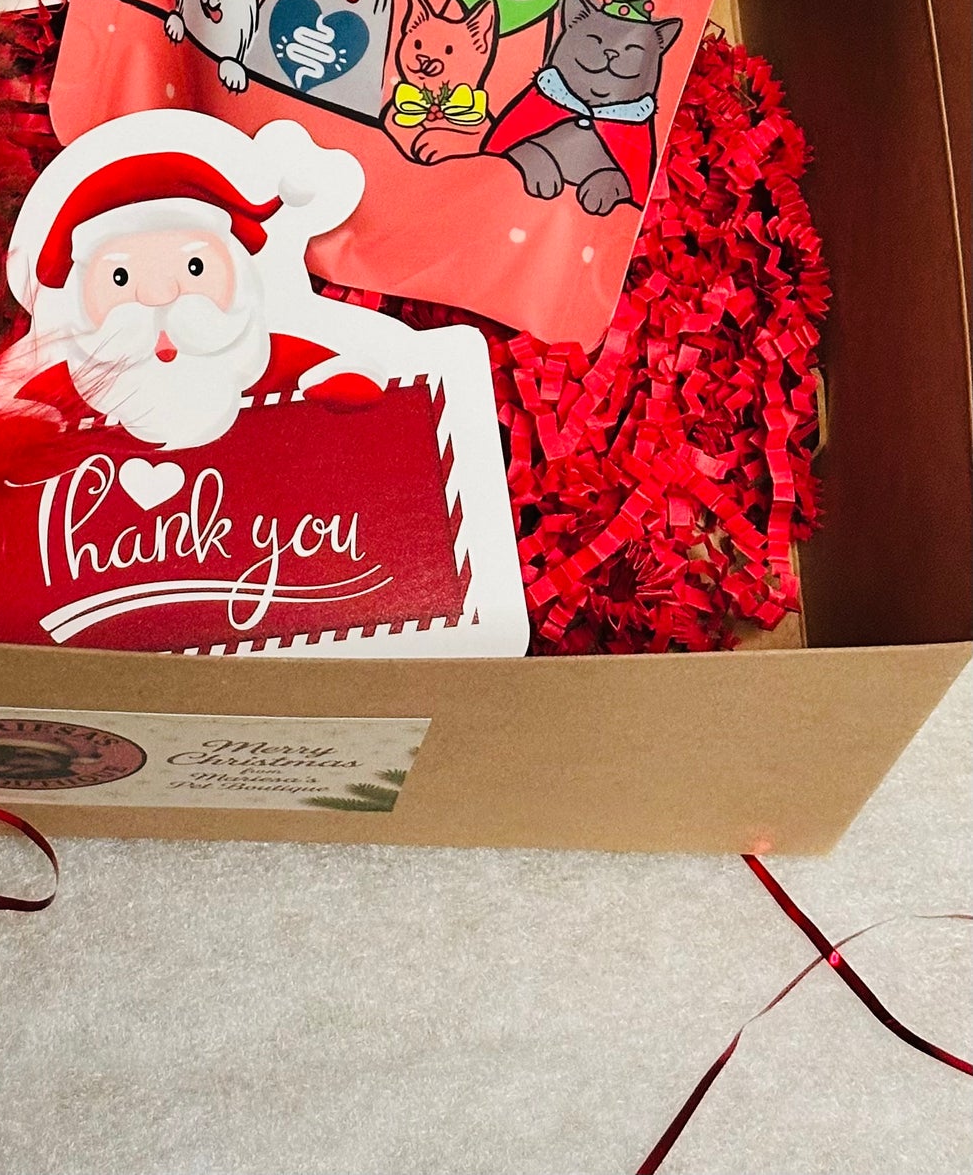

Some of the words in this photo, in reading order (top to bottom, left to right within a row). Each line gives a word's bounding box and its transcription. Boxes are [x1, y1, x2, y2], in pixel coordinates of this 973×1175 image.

[4, 453, 233, 587] Thank
[227, 510, 366, 631] you
[201, 739, 338, 759] Merry
[166, 751, 364, 768] Christmas
[218, 782, 330, 794] Boutique
